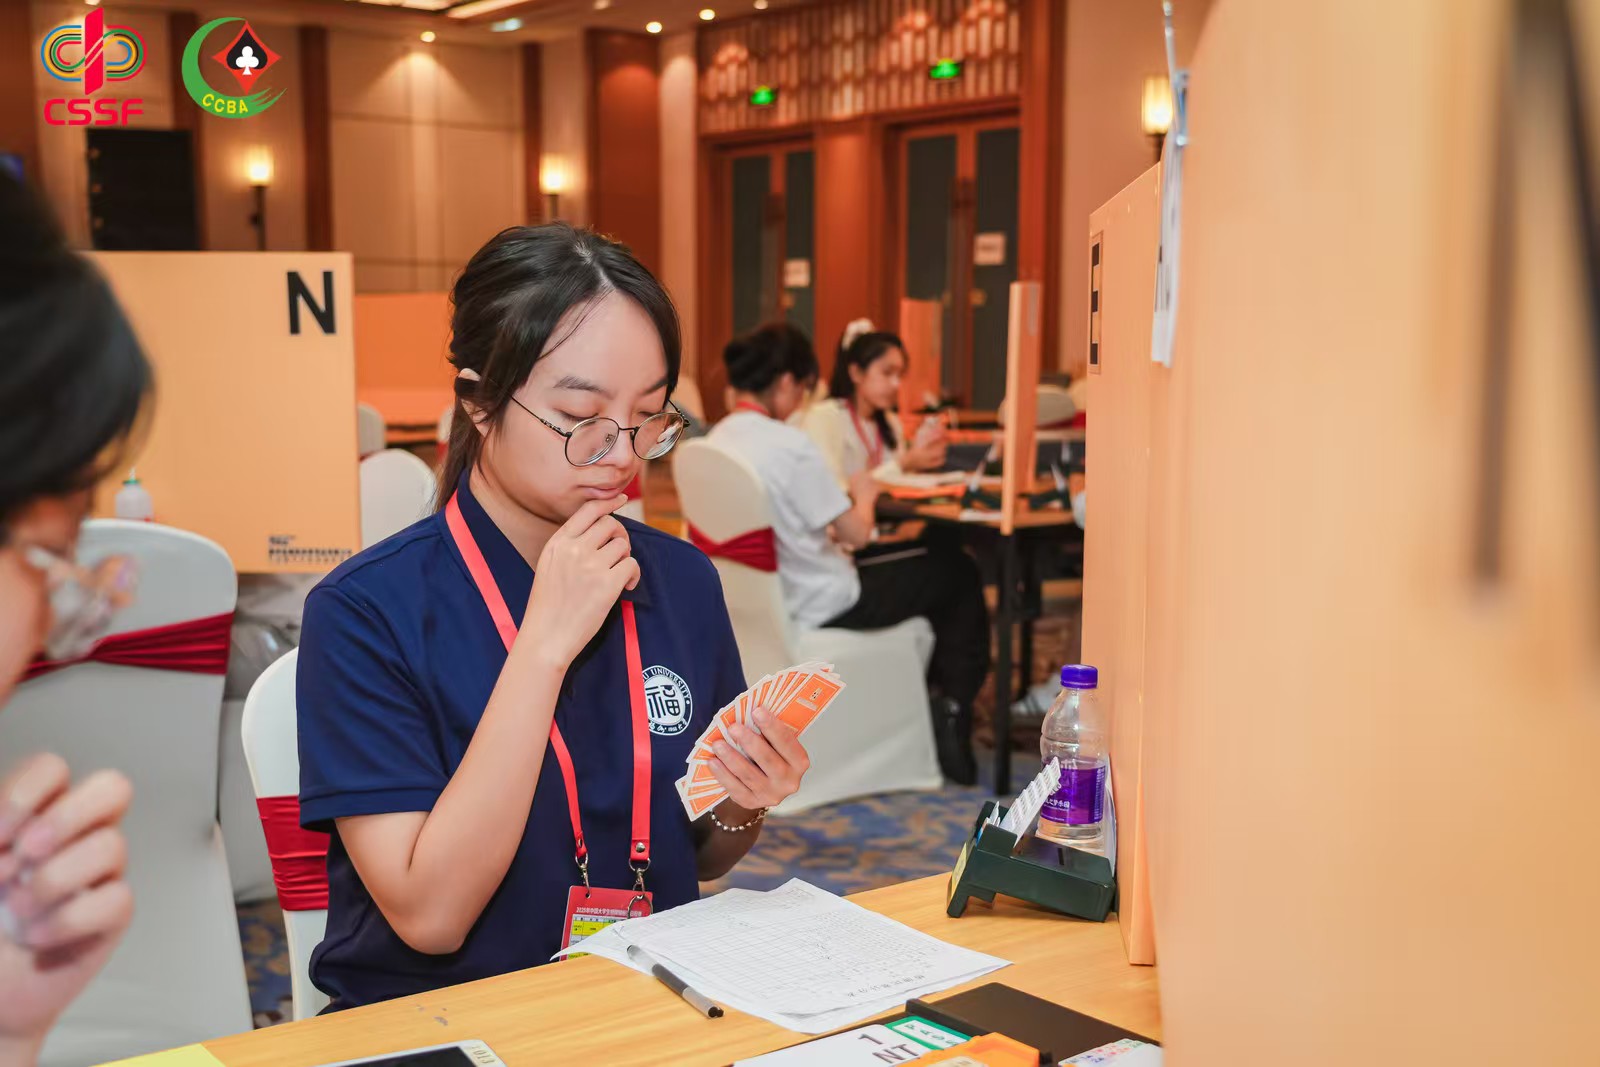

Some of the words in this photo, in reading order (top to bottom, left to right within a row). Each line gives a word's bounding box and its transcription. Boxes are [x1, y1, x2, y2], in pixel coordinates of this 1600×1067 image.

[287, 271, 336, 334] N
[650, 667, 690, 699] UNIVERSITY
[858, 1033, 883, 1045] 1
[904, 1024, 957, 1046] PASS
[872, 1044, 919, 1064] NT
